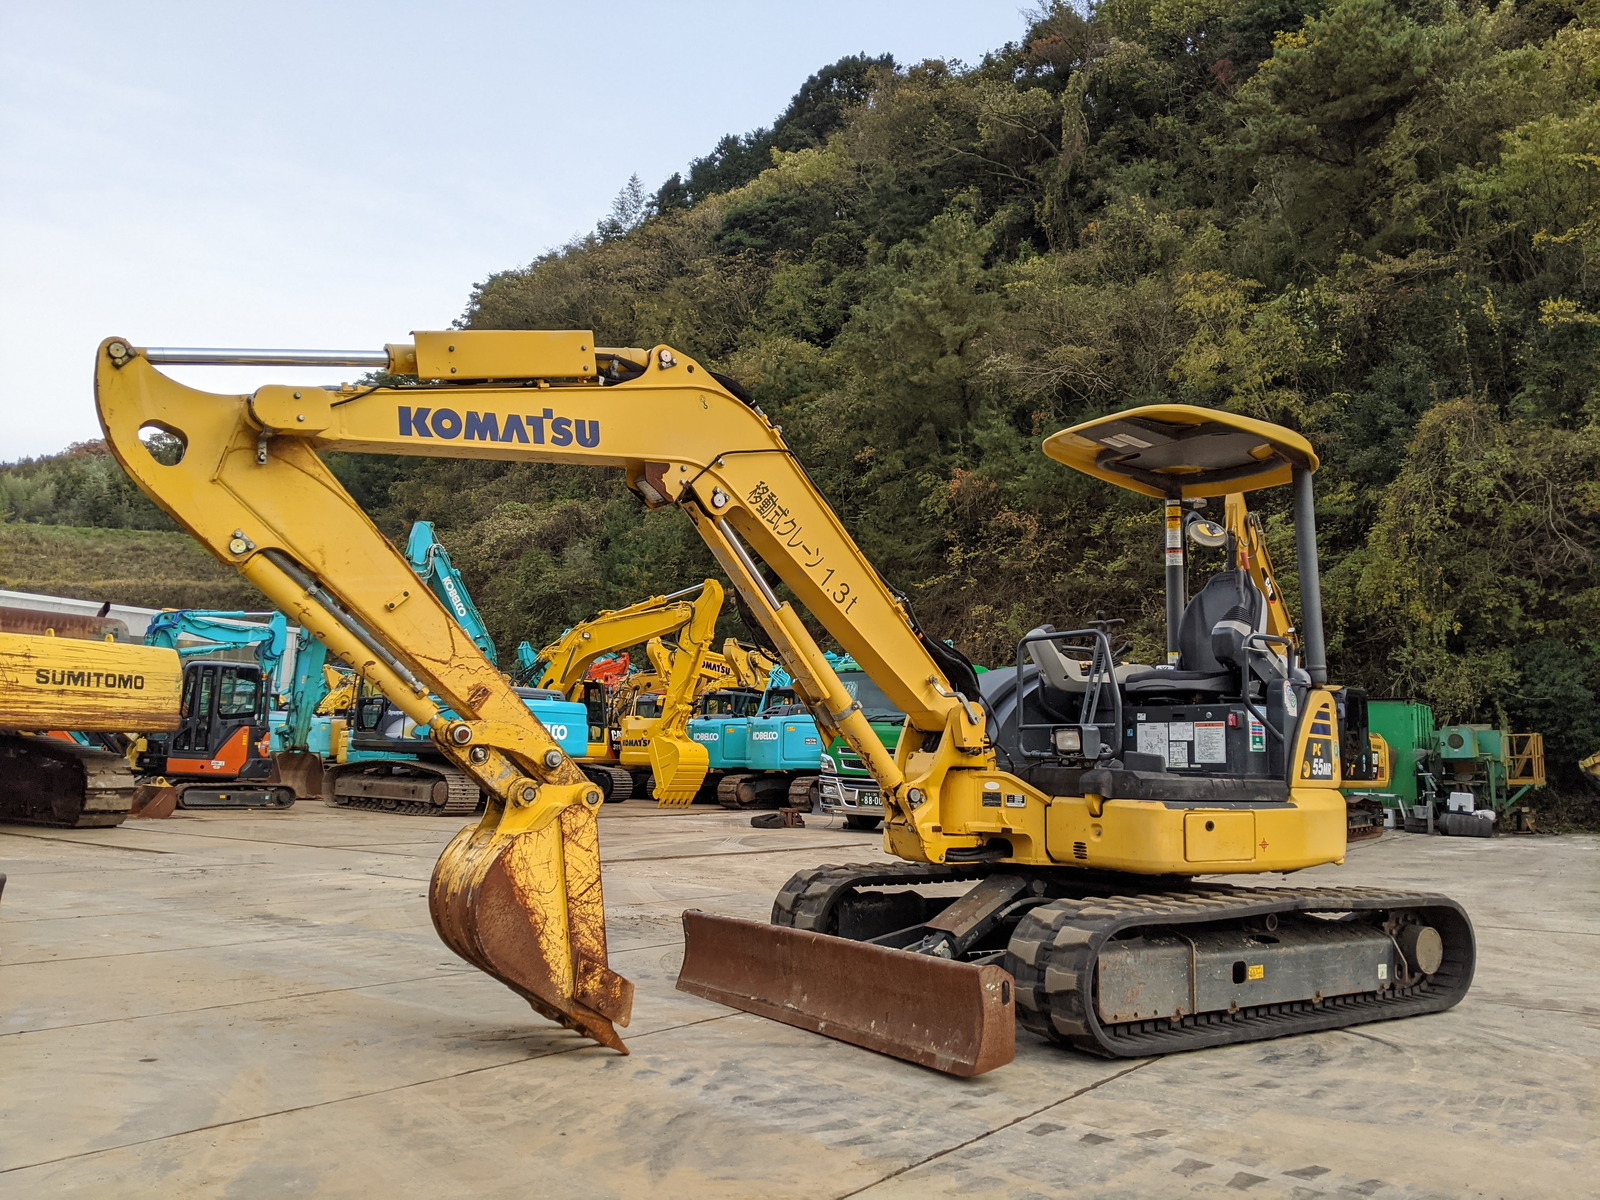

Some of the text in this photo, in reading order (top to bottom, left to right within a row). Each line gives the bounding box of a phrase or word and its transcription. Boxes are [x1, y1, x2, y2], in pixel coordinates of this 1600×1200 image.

[398, 406, 600, 448] KOMATSU
[746, 480, 858, 615] 移動式クレーン 1.3t
[442, 576, 466, 617] KOBELCO
[35, 668, 145, 690] SUMITOMO
[693, 732, 719, 741] KOBELCO
[752, 731, 779, 741] KOBELCO
[1312, 743, 1322, 756] PC
[1312, 757, 1332, 776] 55MR
